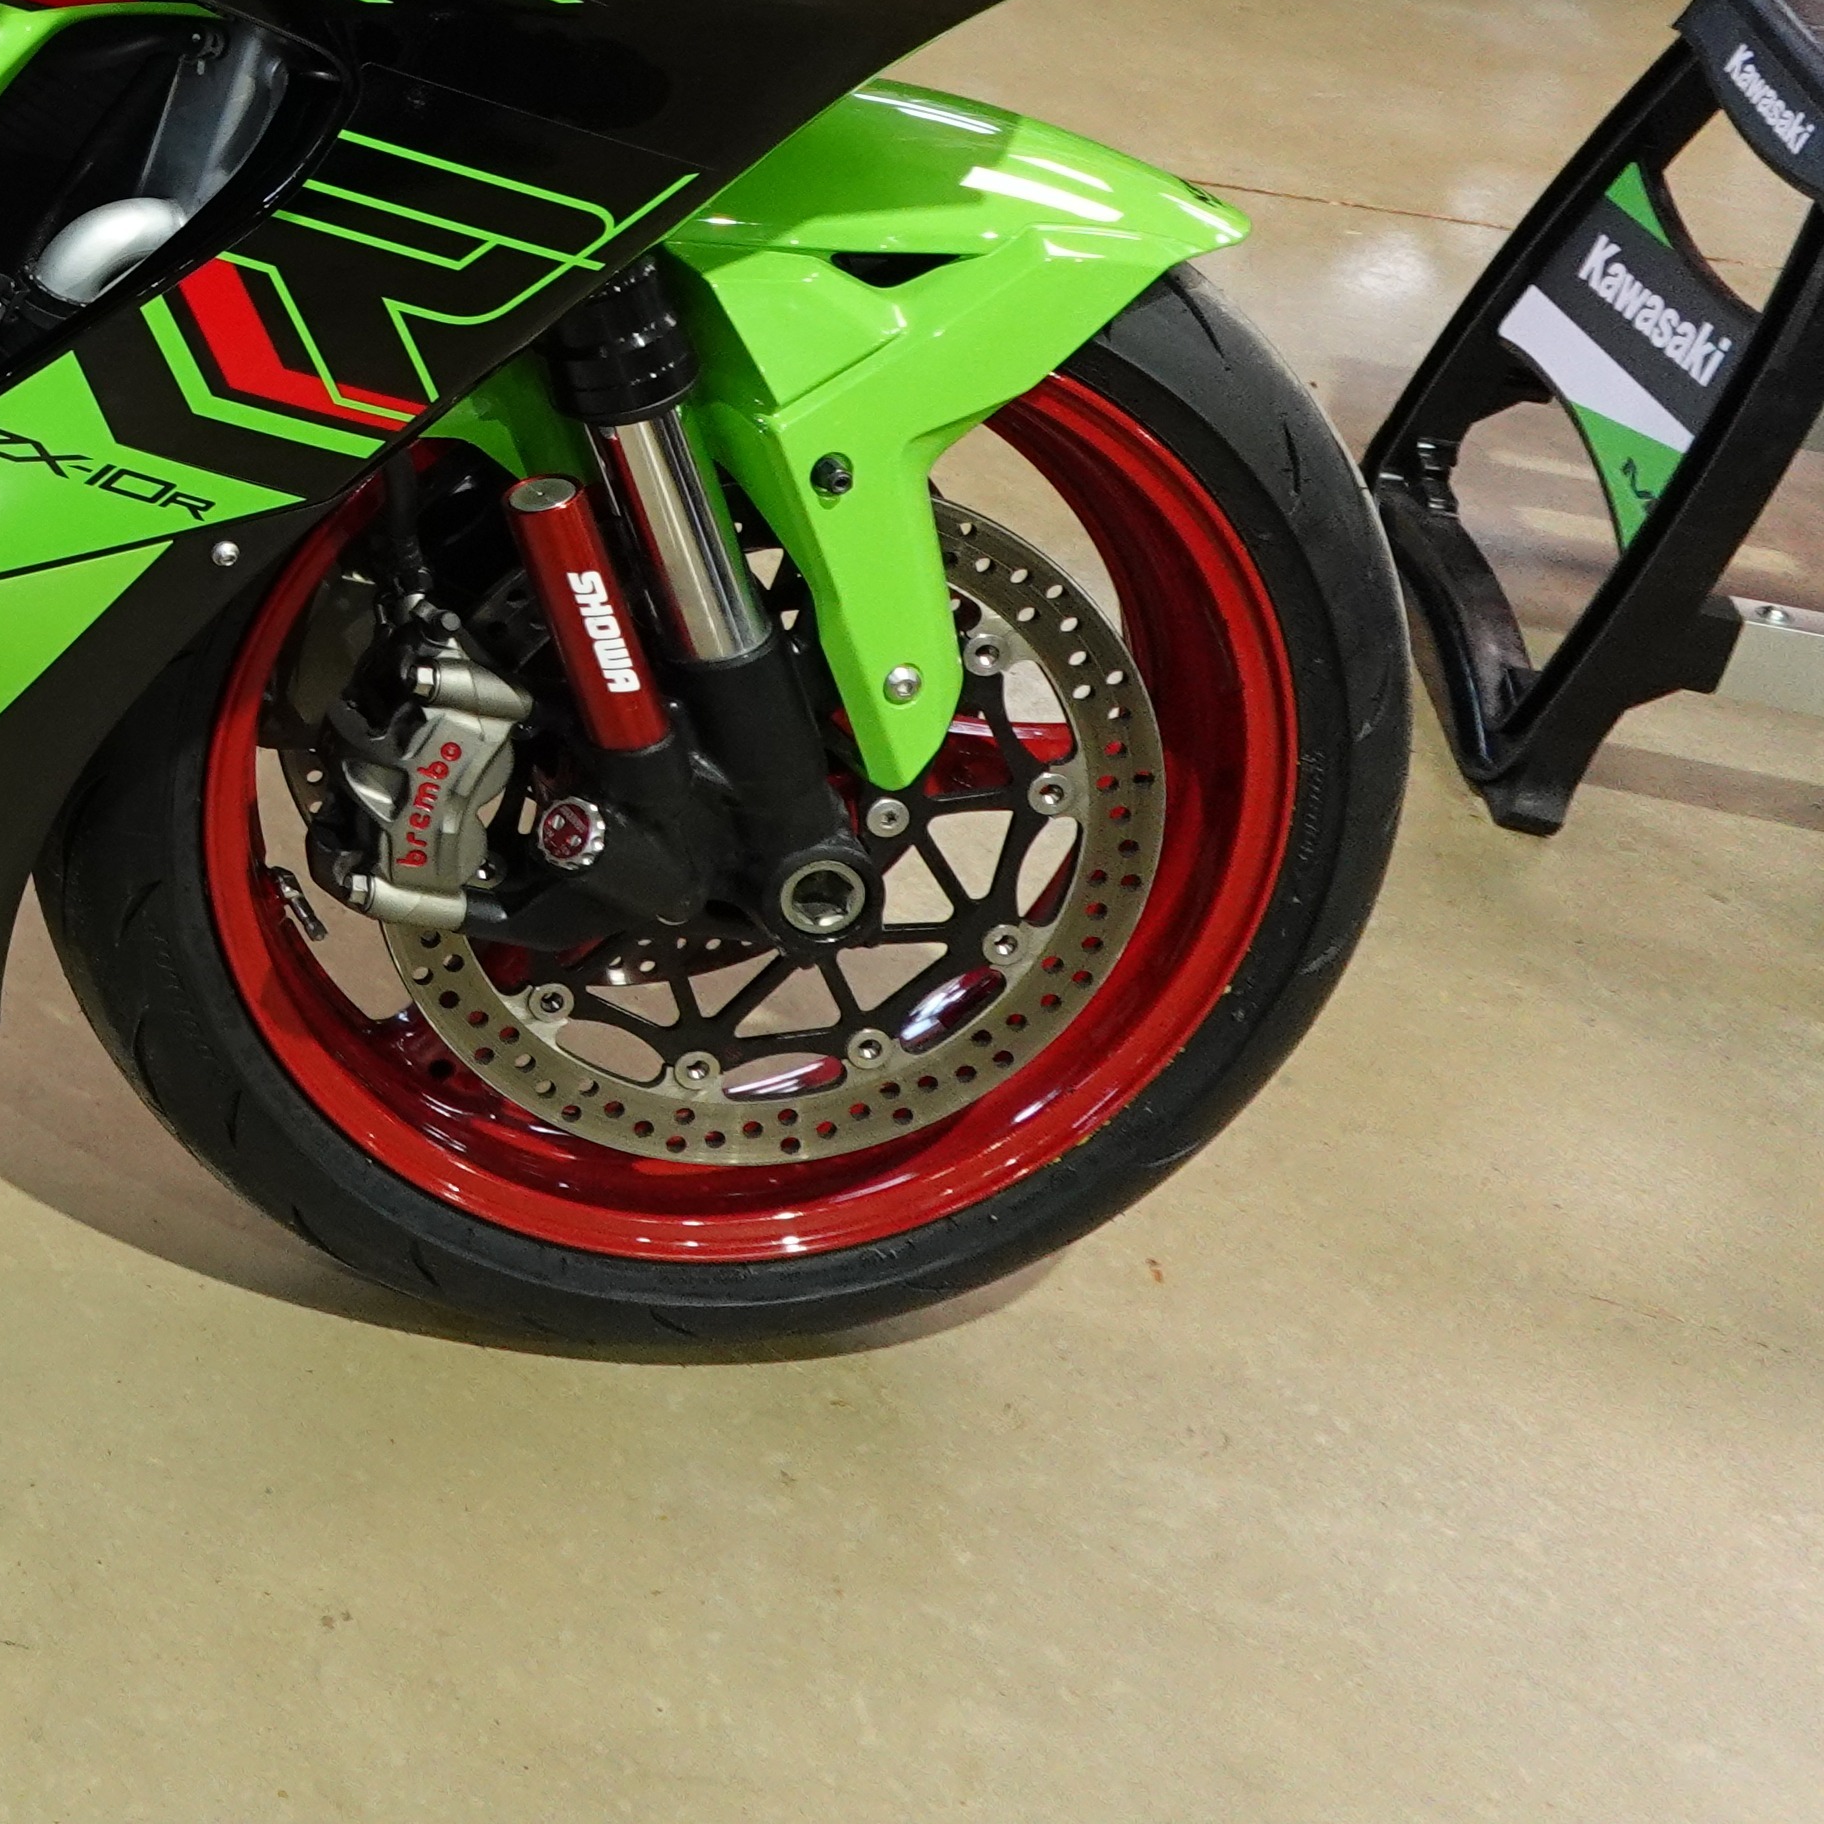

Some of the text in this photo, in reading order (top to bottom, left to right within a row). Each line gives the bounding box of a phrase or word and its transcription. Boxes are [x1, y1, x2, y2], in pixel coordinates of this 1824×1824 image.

[1723, 42, 1816, 155] Kawasaki
[1576, 232, 1734, 389] Kawasaki
[566, 569, 642, 694] SHOWA
[396, 740, 463, 869] brembo
